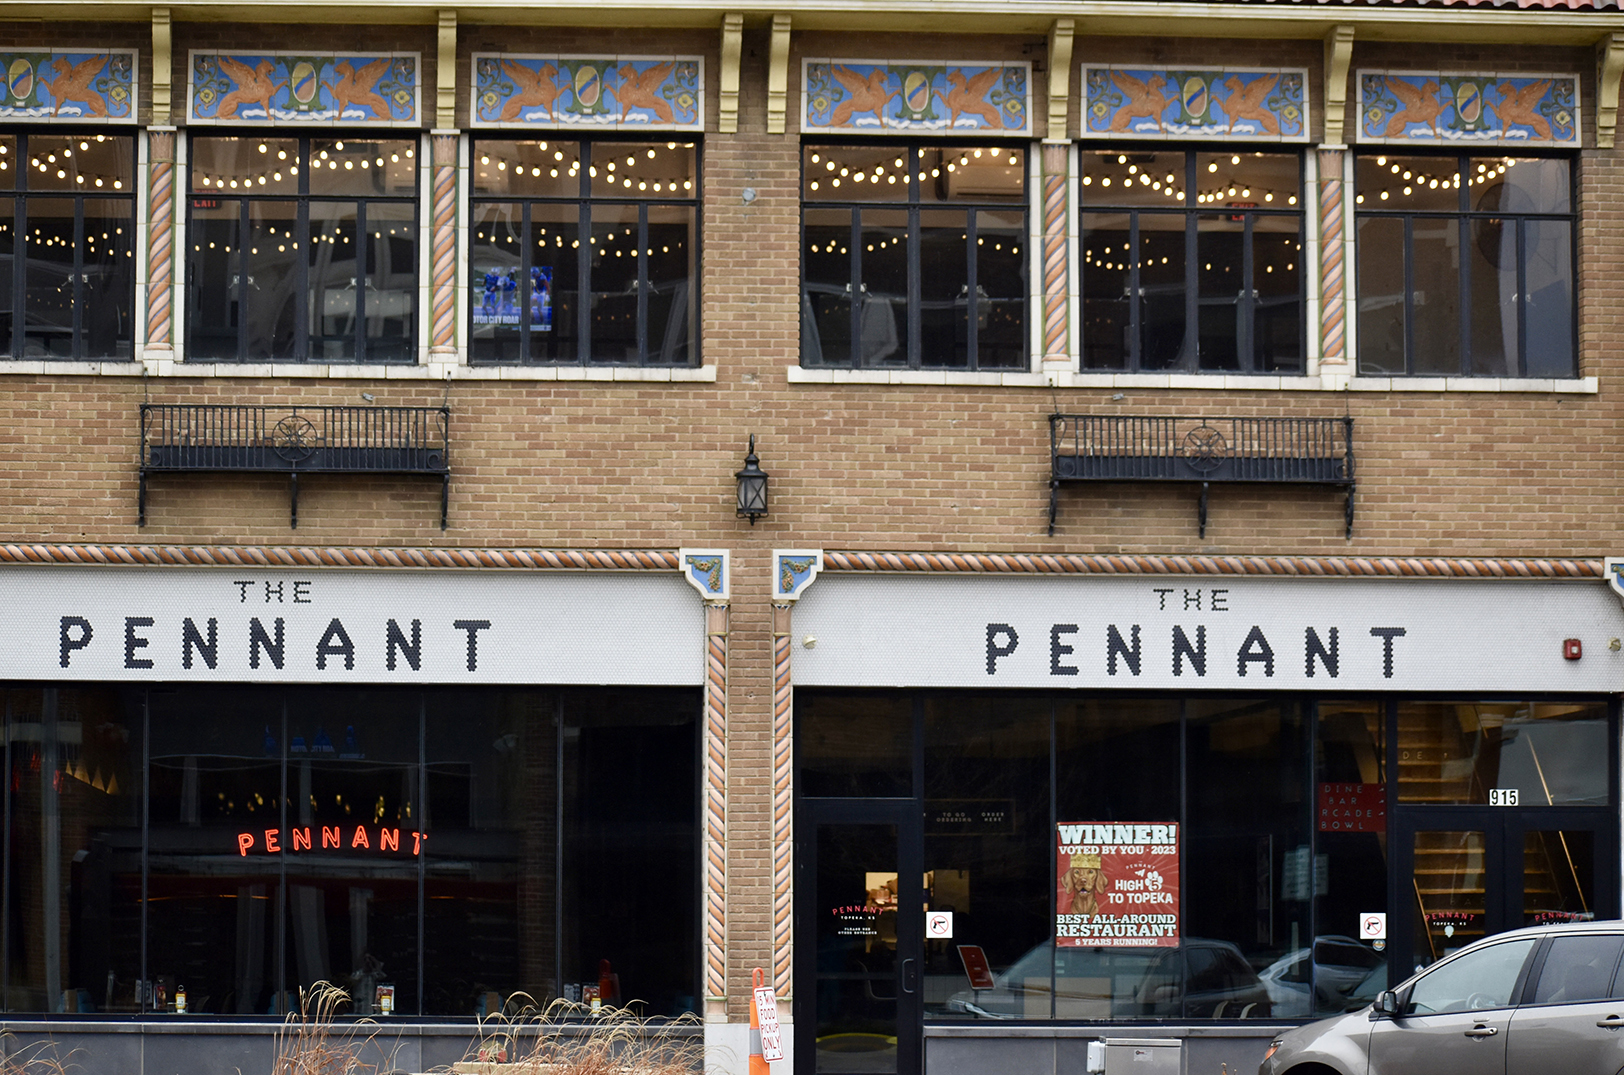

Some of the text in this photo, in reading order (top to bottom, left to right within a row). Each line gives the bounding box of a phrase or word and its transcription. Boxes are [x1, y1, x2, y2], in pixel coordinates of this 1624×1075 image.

[234, 581, 311, 603] THE
[1153, 588, 1229, 611] THE
[59, 616, 491, 672] PENNANT
[985, 623, 1407, 678] PENNANT
[1324, 785, 1363, 794] DINE
[1328, 797, 1357, 805] BAR
[1491, 790, 1517, 805] 915
[1321, 821, 1363, 830] BOWL
[1058, 824, 1177, 845] WINNER!
[238, 825, 428, 857] PENNANT
[1059, 845, 1176, 854] VOTED BY YOU 2023
[1115, 879, 1144, 891] HIGH
[1108, 892, 1174, 904] TO TOPEKA
[832, 905, 883, 916] PENNANT
[1425, 911, 1475, 921] PENNANT
[1534, 911, 1584, 922] PENNANT
[1056, 914, 1176, 924] BEST ALL-AROUND
[1056, 925, 1177, 937] RESTAURANT
[760, 1007, 776, 1021] FOOD
[763, 1035, 781, 1051] ONLY
